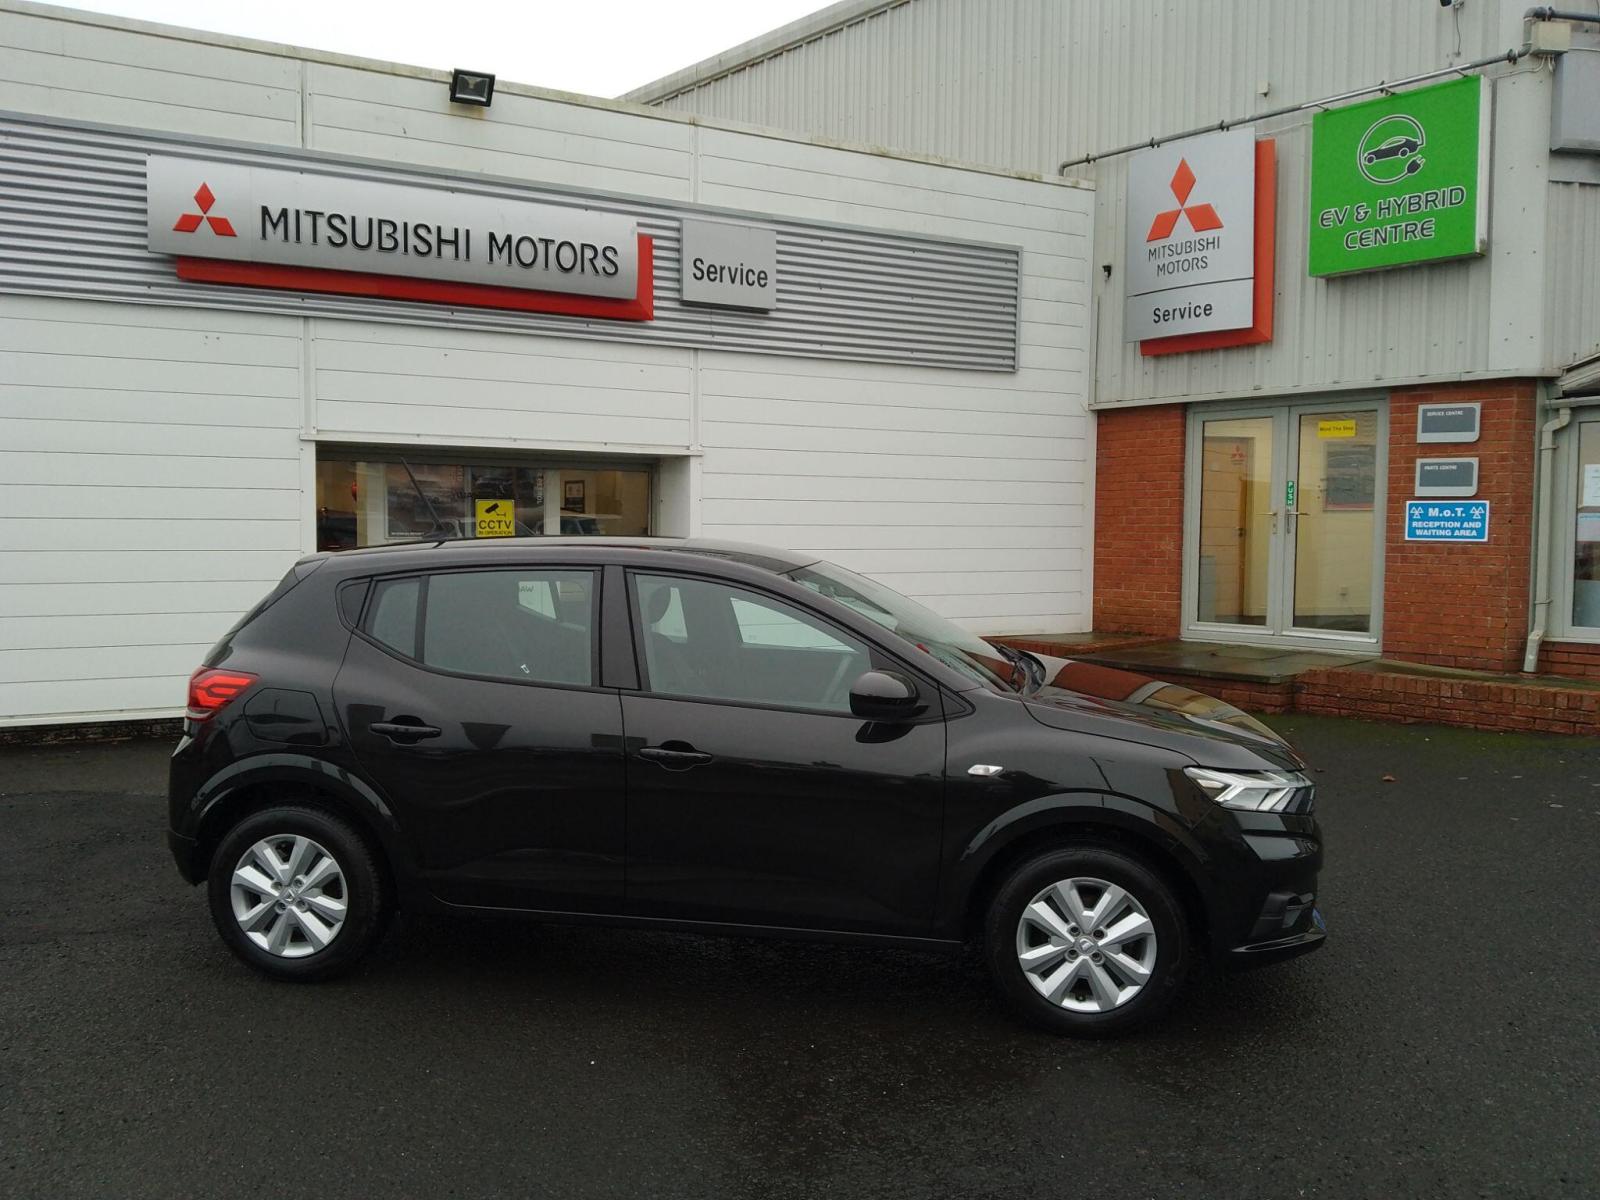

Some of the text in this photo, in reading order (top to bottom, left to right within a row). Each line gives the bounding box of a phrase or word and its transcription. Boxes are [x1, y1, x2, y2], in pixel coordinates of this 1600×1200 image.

[1320, 186, 1466, 228] EV & HYBRID
[260, 205, 619, 277] MITSUBISHI MOTORS
[1344, 218, 1435, 250] CENTRE
[1148, 236, 1220, 262] MITSUBISHI
[692, 258, 768, 288] Service
[1157, 255, 1208, 277] MOTORS
[1153, 302, 1213, 324] Service
[1428, 507, 1466, 517] M.o.T.
[478, 519, 512, 530] CCTV
[1415, 529, 1478, 537] WAITING AREA
[1462, 520, 1482, 528] AND
